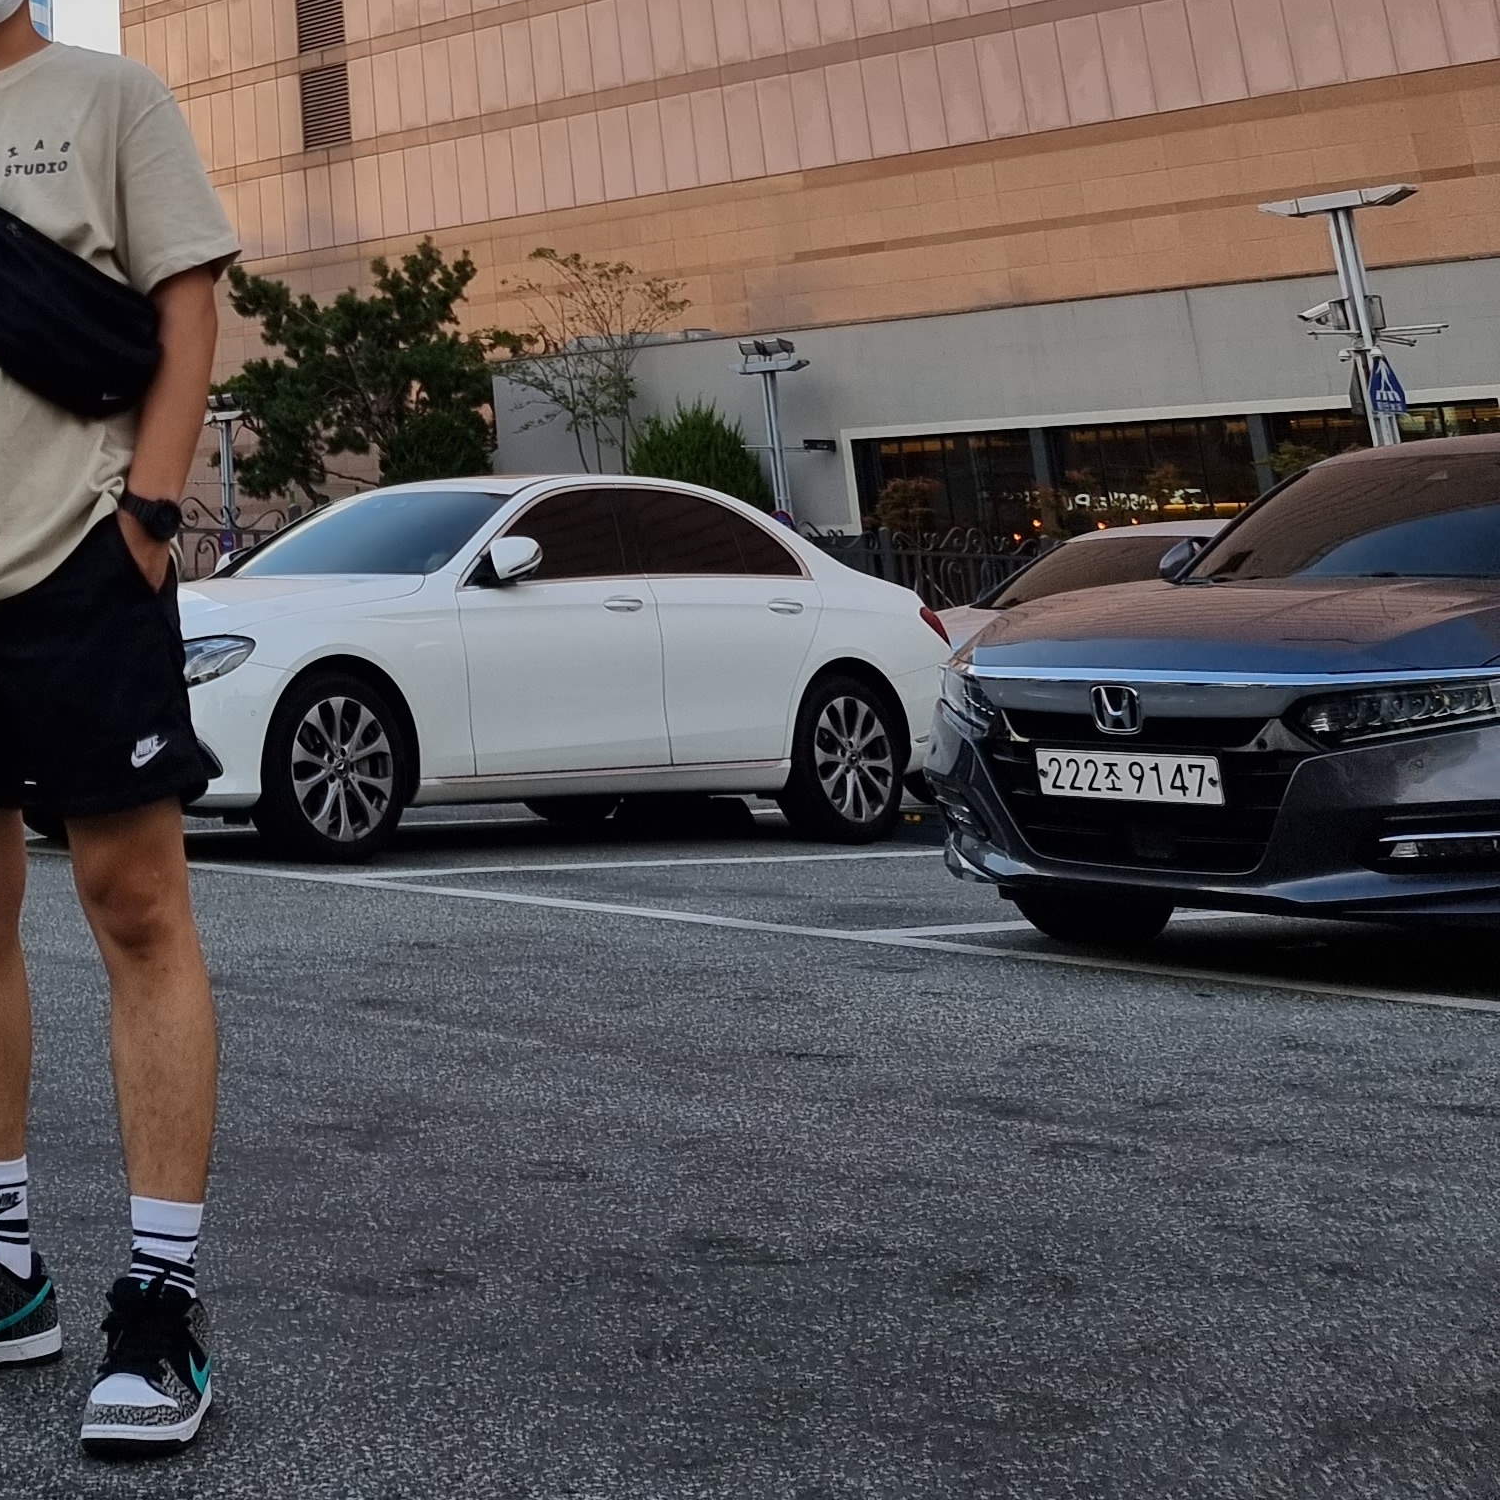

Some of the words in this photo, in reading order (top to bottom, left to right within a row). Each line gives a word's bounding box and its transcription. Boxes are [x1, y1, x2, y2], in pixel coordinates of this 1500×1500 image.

[4, 161, 68, 177] STUDIO
[136, 735, 160, 757] NIKE
[1049, 757, 1206, 798] 222조9147
